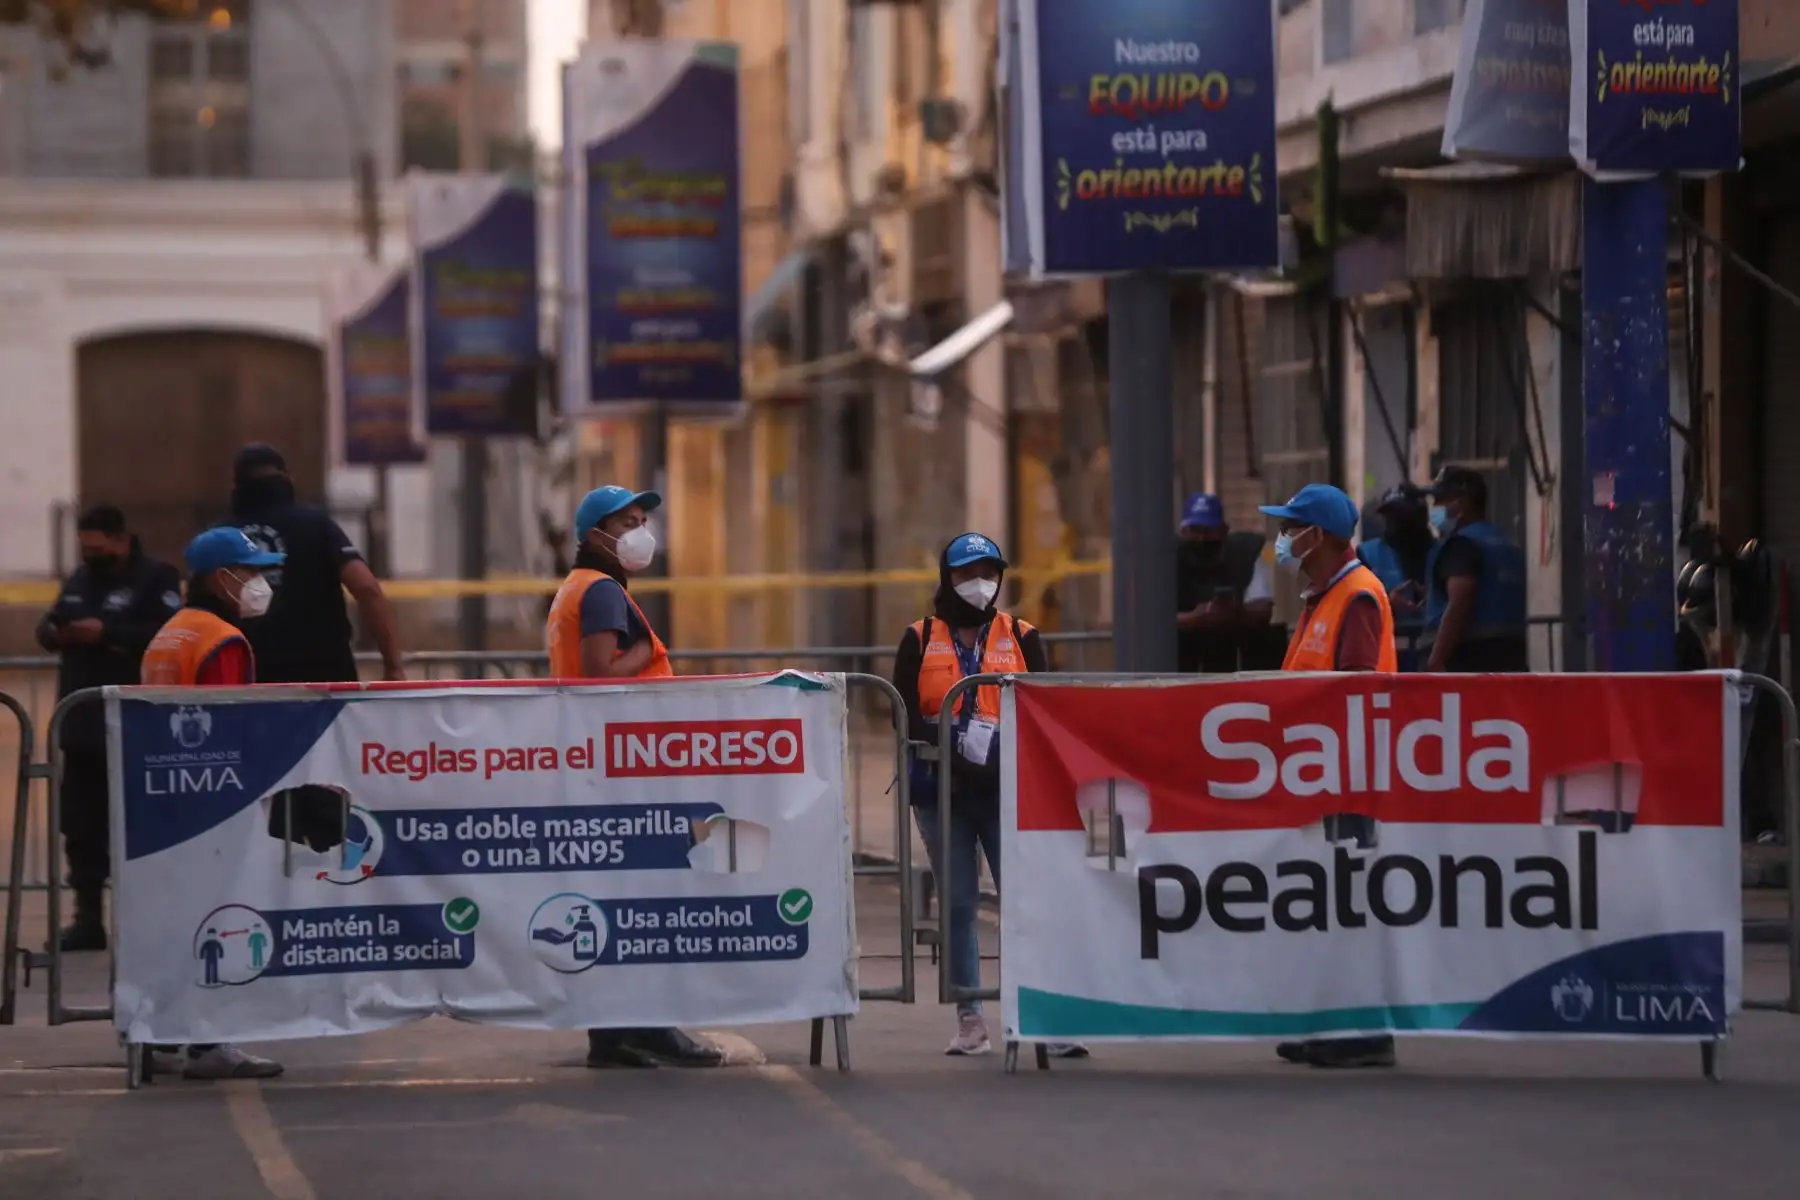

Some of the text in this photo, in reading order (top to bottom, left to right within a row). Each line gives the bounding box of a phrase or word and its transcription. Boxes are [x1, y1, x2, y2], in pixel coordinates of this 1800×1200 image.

[1633, 16, 1694, 52] está para
[1115, 39, 1200, 64] Nuestro
[1610, 50, 1720, 94] orientarte
[1088, 71, 1230, 120] EQUIPO
[1112, 124, 1207, 158] está para
[1076, 157, 1246, 200] orientarte
[361, 738, 594, 781] Reglas para el
[613, 730, 798, 768] INGRESO
[1200, 692, 1530, 798] Salida
[145, 766, 244, 794] LIMA
[396, 810, 690, 841] Usa doble mascarilla
[461, 841, 625, 867] o una KN95
[1137, 831, 1599, 959] peatonal
[282, 914, 400, 941] Mantén la
[616, 905, 753, 929] Usa alcohol
[282, 938, 462, 966] distancia social
[617, 934, 797, 961] para tus manos
[1616, 995, 1715, 1021] LIMA
